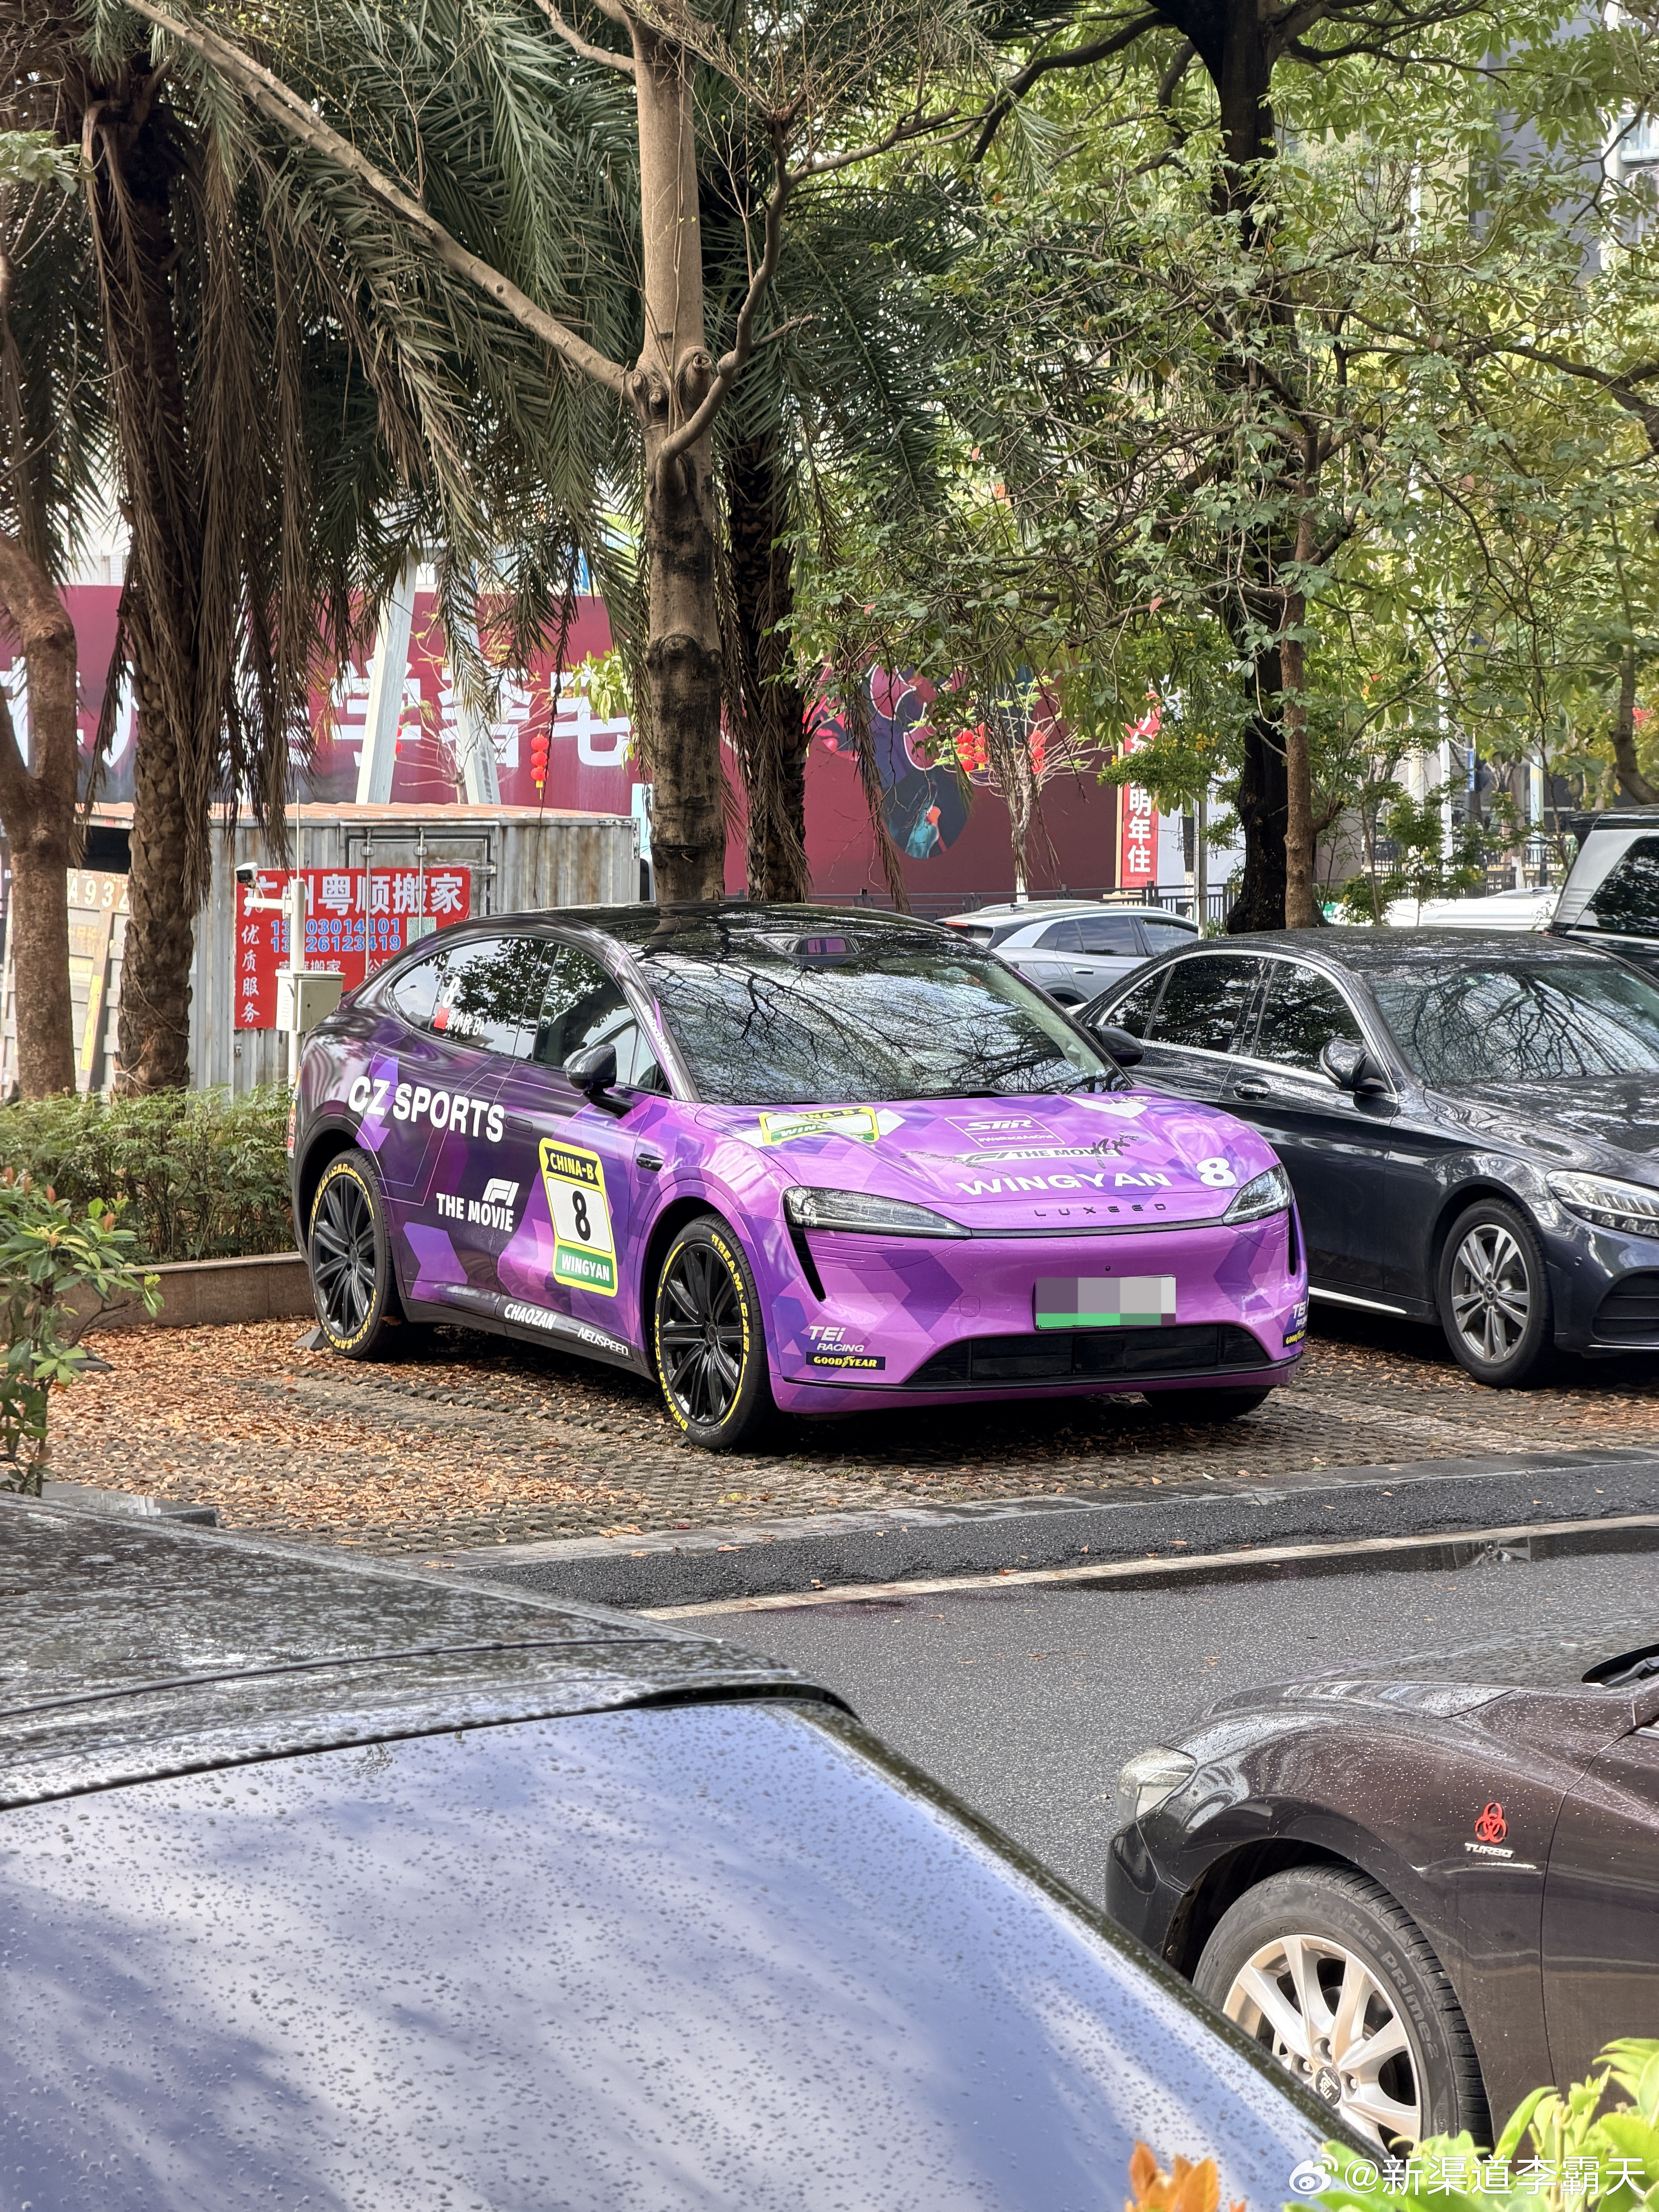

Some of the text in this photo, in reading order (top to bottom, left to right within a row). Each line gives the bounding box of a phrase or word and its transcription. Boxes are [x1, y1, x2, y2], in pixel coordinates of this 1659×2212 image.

[271, 918, 399, 936] 1303014101
[271, 935, 401, 952] 1326123419
[241, 924, 260, 1023] 优质服务
[442, 976, 461, 1008] 8
[349, 1076, 505, 1142] CZ SPORTS
[797, 1110, 855, 1119] INA-B
[550, 1152, 594, 1180] CHINA-B
[1012, 1150, 1051, 1158] THE
[1055, 1148, 1114, 1156] MOVIE
[955, 1157, 1237, 1195] WINGYAN 8
[482, 1178, 520, 1207] F1
[436, 1193, 514, 1232] THE MOVIE
[572, 1190, 591, 1241] 8
[1034, 1203, 1167, 1217] LUXEED
[562, 1254, 610, 1282] WINGYAN
[504, 1304, 557, 1329] CHAOZAN
[577, 1327, 629, 1356] NEUSPEED
[809, 1326, 846, 1341] TEi
[816, 1343, 865, 1352] RACING
[813, 1356, 877, 1368] GOODYEAR
[1465, 1842, 1514, 1858] TURBO
